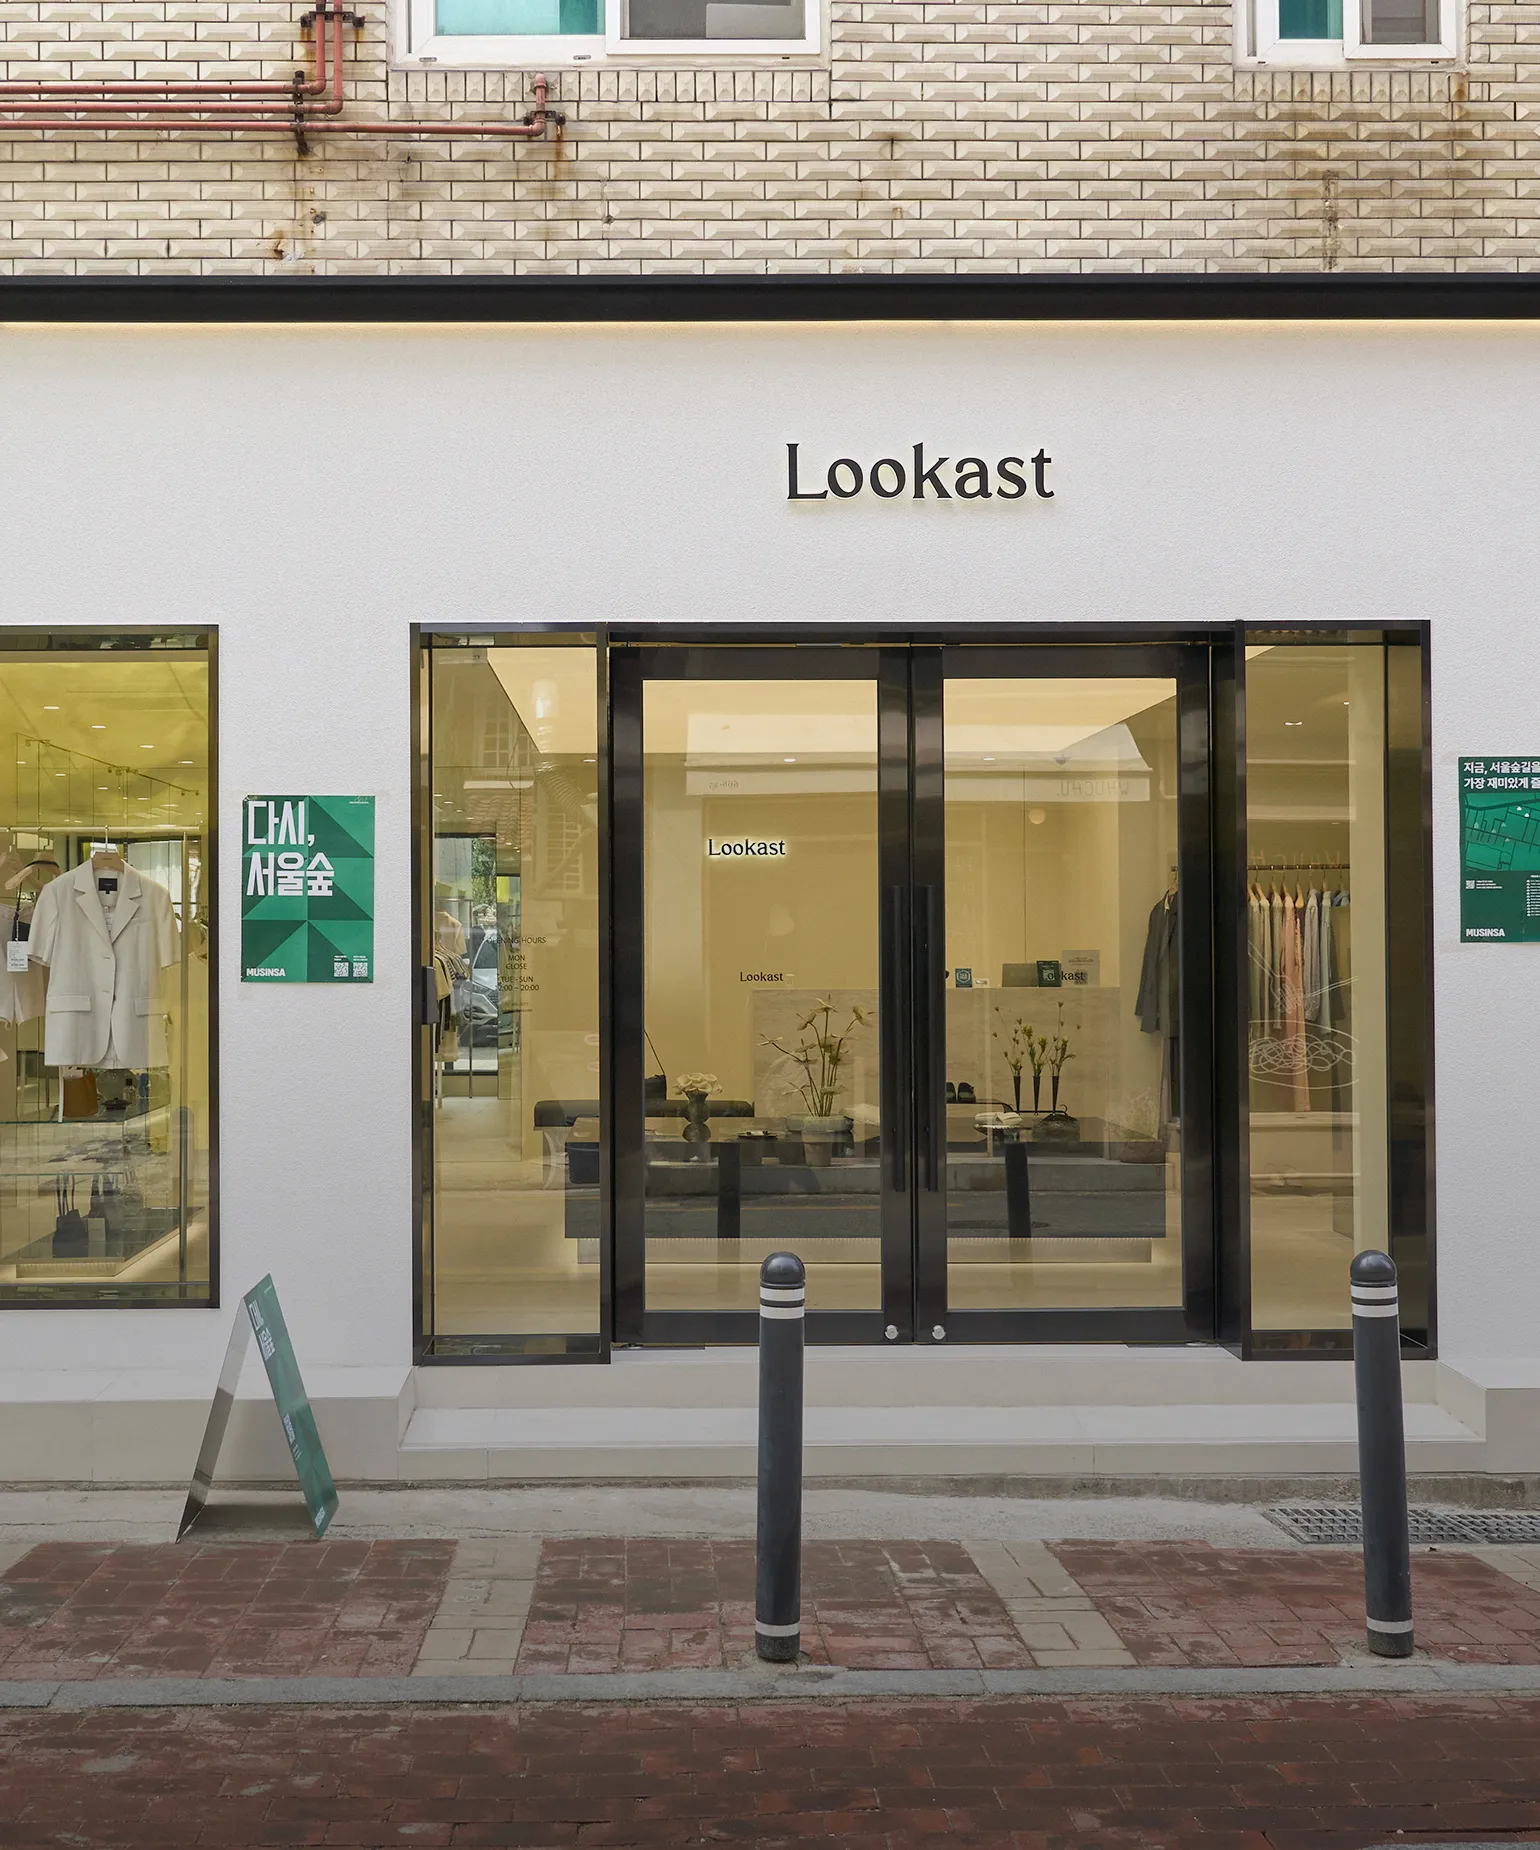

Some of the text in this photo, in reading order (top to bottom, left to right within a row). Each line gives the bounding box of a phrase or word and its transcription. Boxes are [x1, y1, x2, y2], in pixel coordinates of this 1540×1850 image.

[786, 442, 1055, 499] Lookast
[1463, 761, 1540, 775] 지금, 서울숲길을
[1463, 776, 1486, 789] 가장
[1487, 776, 1529, 789] 재미있게
[247, 800, 315, 847] 다시,
[708, 839, 786, 856] Lookast
[246, 851, 335, 896] 서울숲
[1465, 928, 1506, 937] MUSINSA
[246, 967, 286, 977] MUSINSA
[740, 971, 784, 982] Lookast
[519, 975, 534, 983] SUN
[520, 984, 540, 992] 20:00
